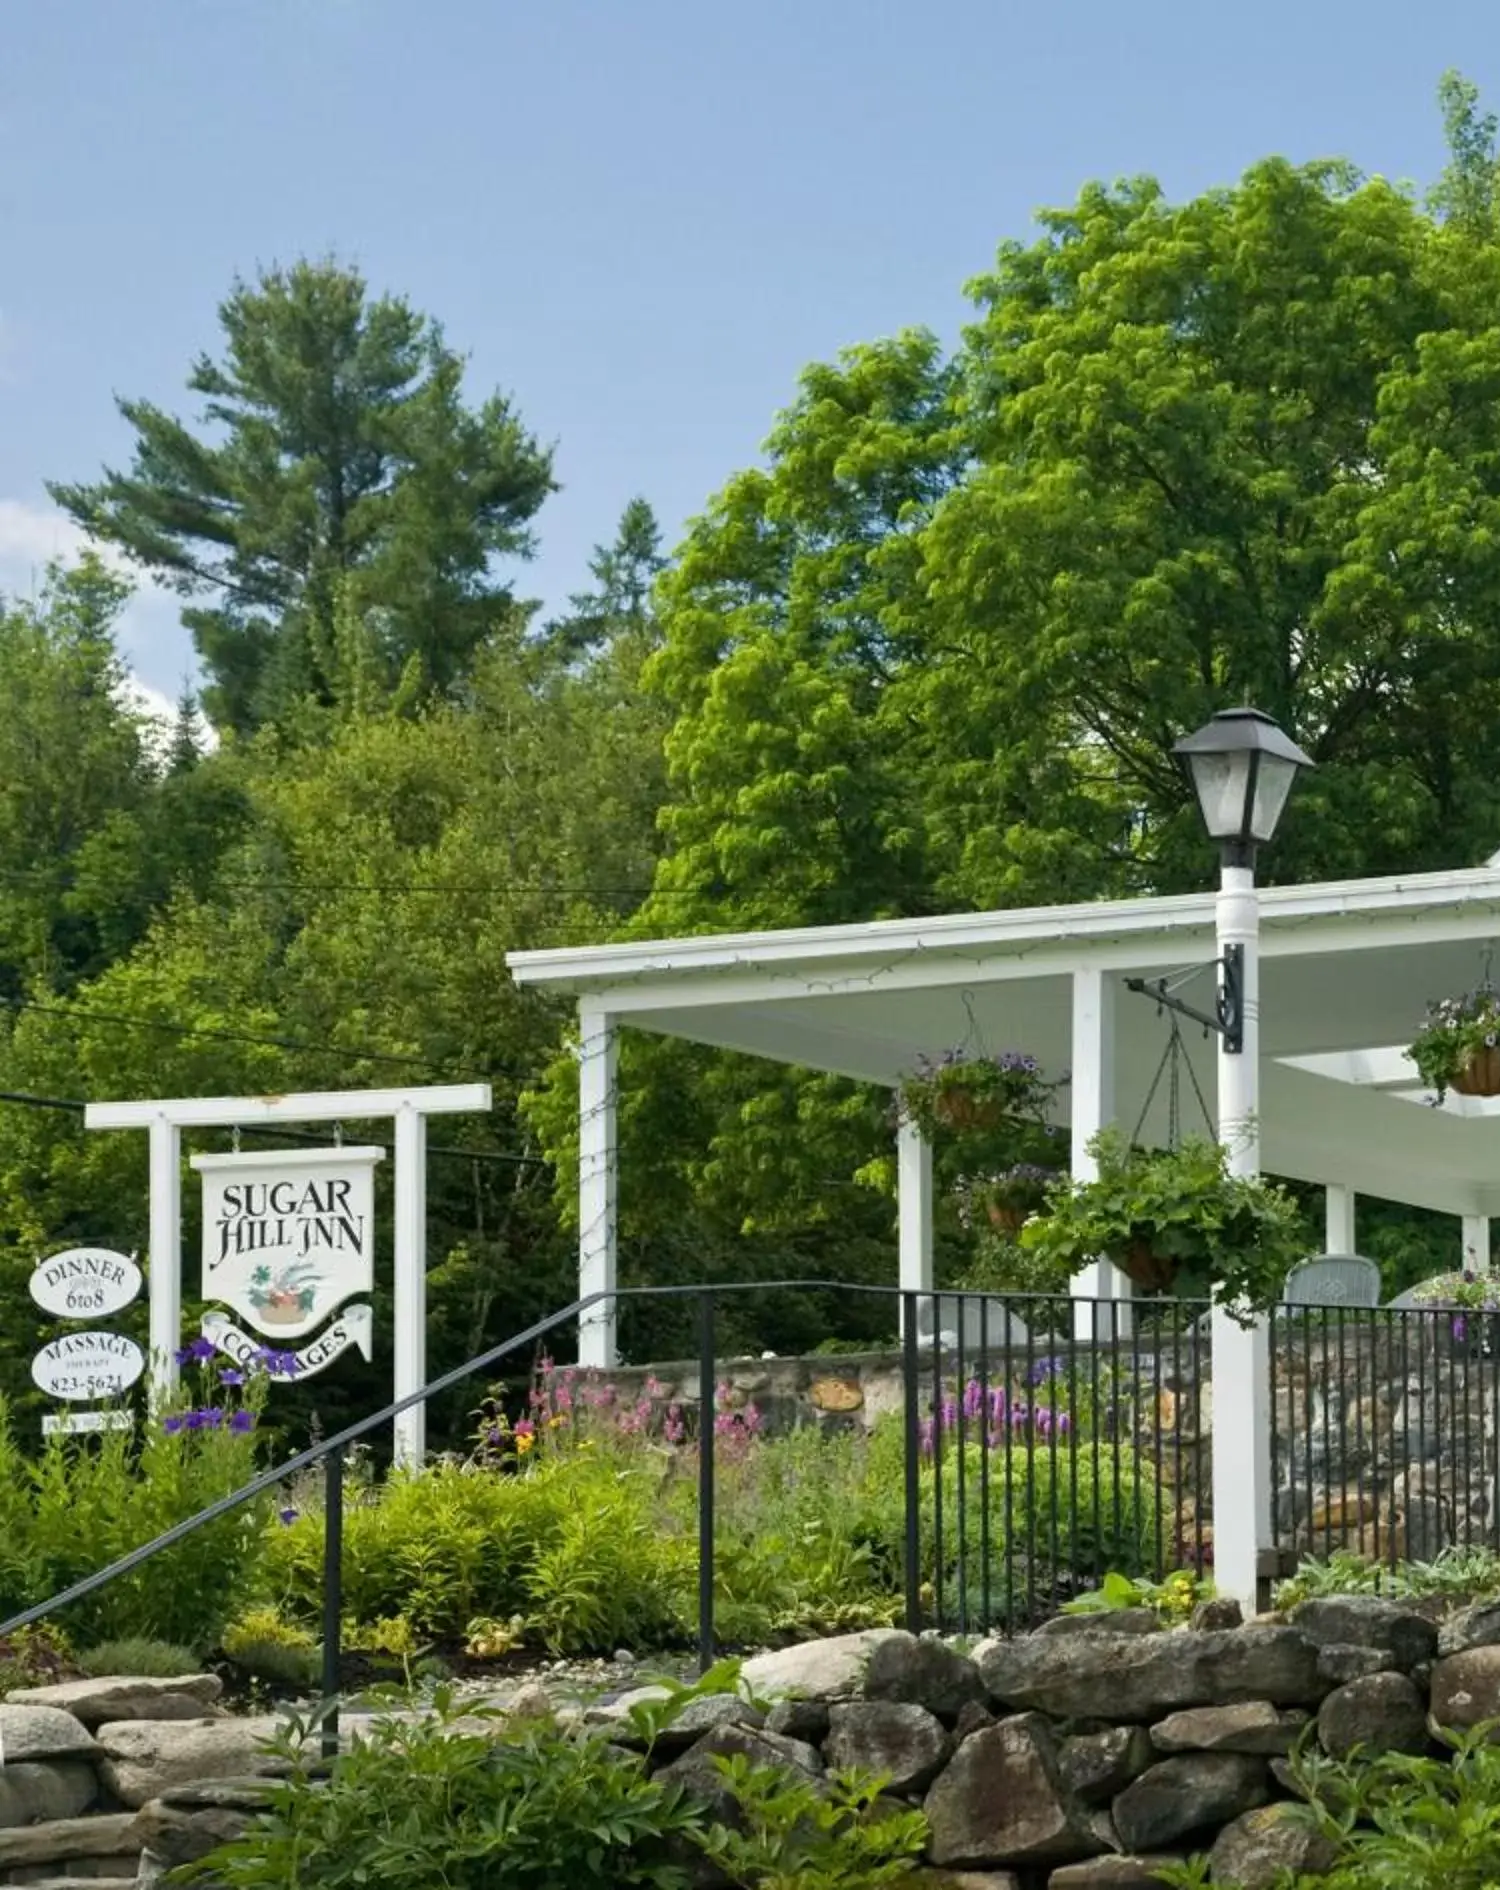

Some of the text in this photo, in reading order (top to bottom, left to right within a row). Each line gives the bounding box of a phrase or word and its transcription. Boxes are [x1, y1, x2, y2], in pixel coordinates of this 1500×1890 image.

[221, 1179, 354, 1221] SUGAR
[208, 1215, 365, 1272] HILL INN
[45, 1257, 126, 1287] DINNER
[45, 1336, 133, 1360] MASSAGE
